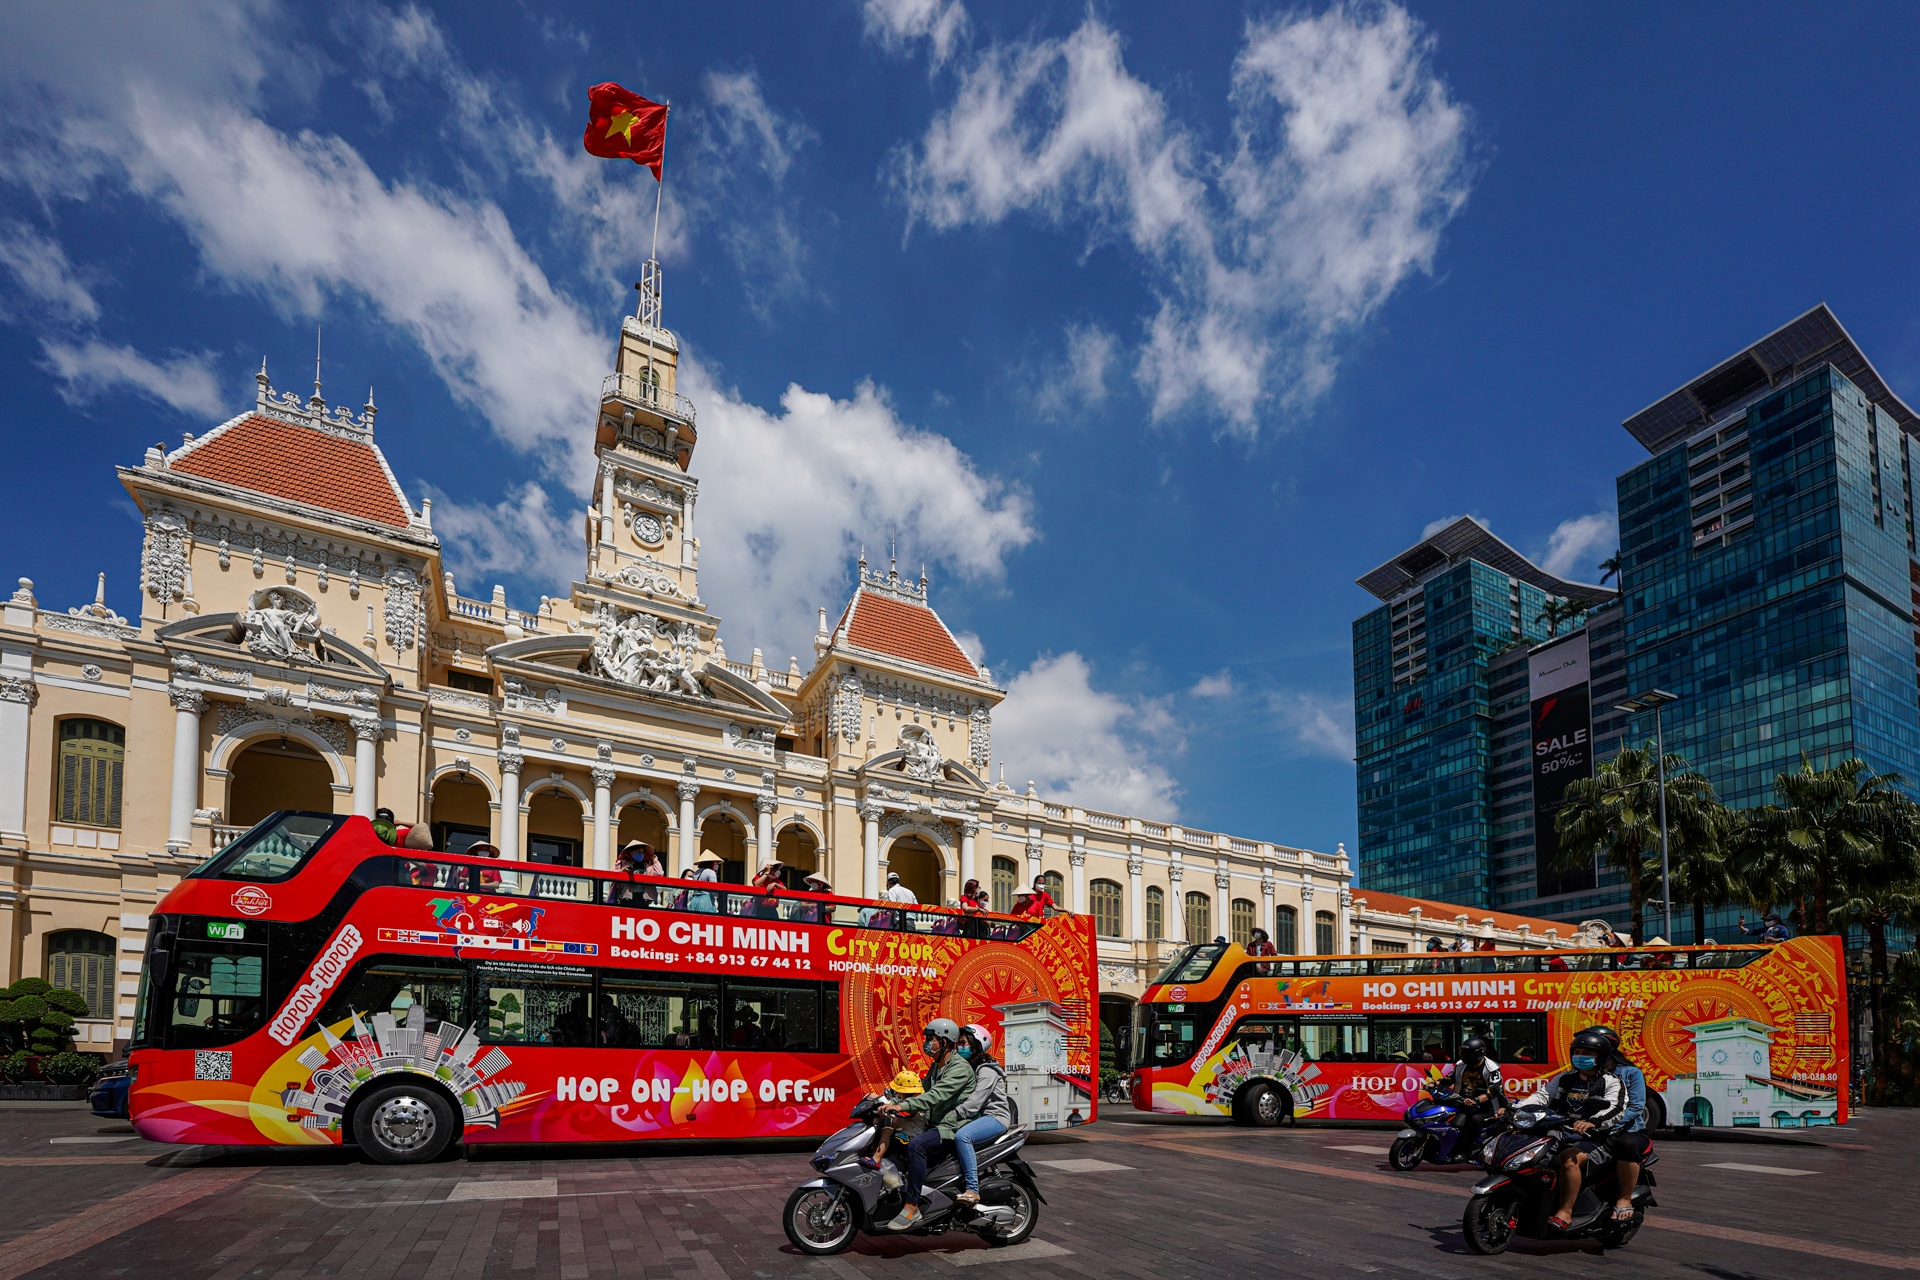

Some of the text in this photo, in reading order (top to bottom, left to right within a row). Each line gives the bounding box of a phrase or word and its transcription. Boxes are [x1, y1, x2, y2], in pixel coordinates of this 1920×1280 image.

[1536, 728, 1587, 756] SALE
[1541, 754, 1575, 774] 50%
[611, 916, 810, 953] HO CHI MINH
[610, 945, 811, 970] Booking: +84 913 67 44 12
[886, 941, 933, 961] TOUR
[828, 960, 937, 978] HOPON-HOPOFF.VN
[1363, 980, 1515, 997] HO CHI MINH
[1570, 980, 1681, 994] SIGHTSEEING
[1362, 1000, 1517, 1012] Booking: +84 913 67 44 12
[557, 1077, 620, 1102] HOP
[1351, 1076, 1397, 1091] HOP
